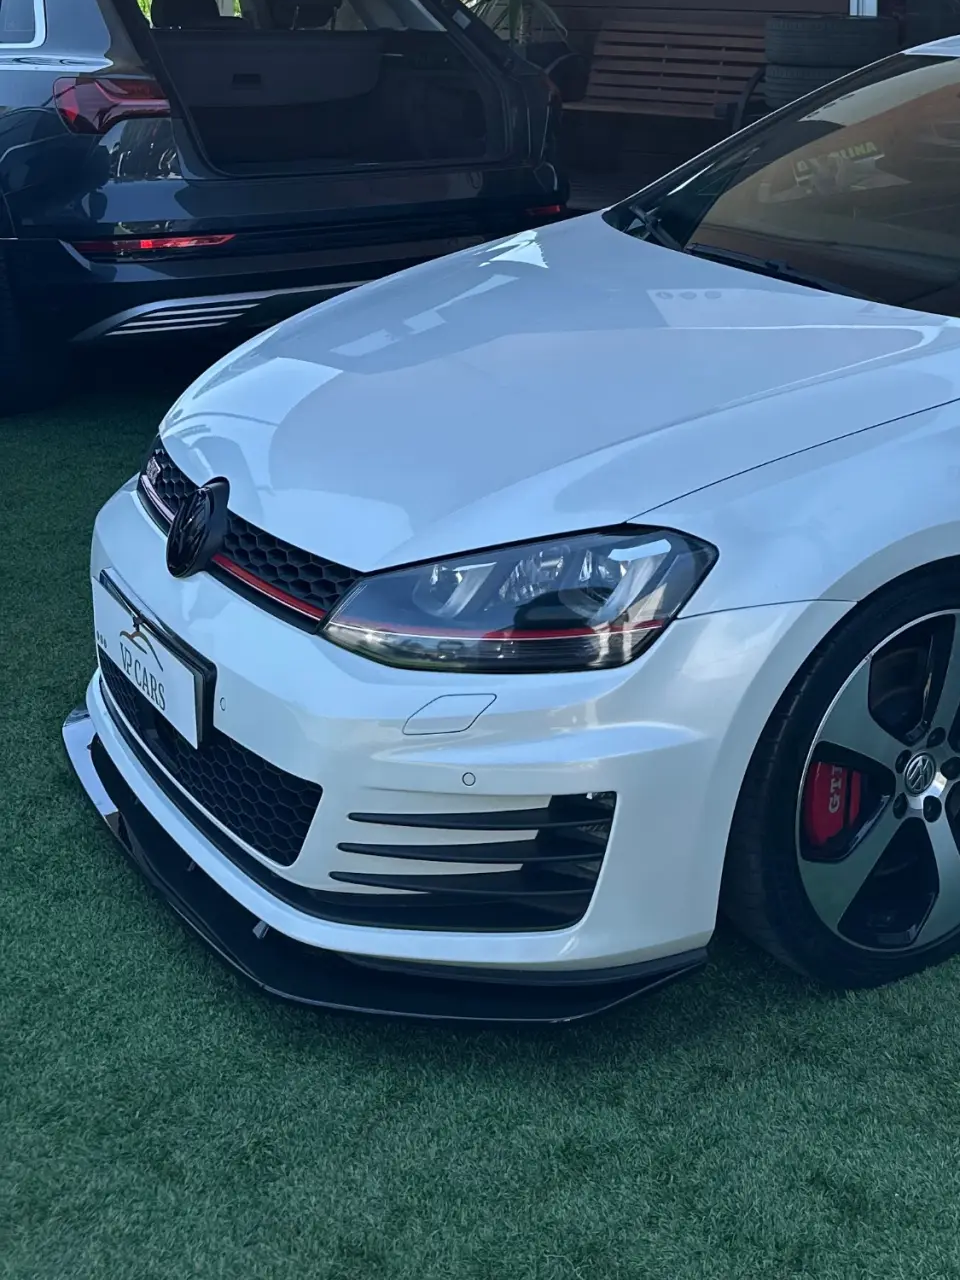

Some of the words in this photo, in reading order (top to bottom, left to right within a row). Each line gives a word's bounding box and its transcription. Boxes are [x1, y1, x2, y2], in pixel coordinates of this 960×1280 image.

[119, 641, 133, 676] VP
[134, 659, 166, 711] CARS
[828, 765, 843, 814] GTI
